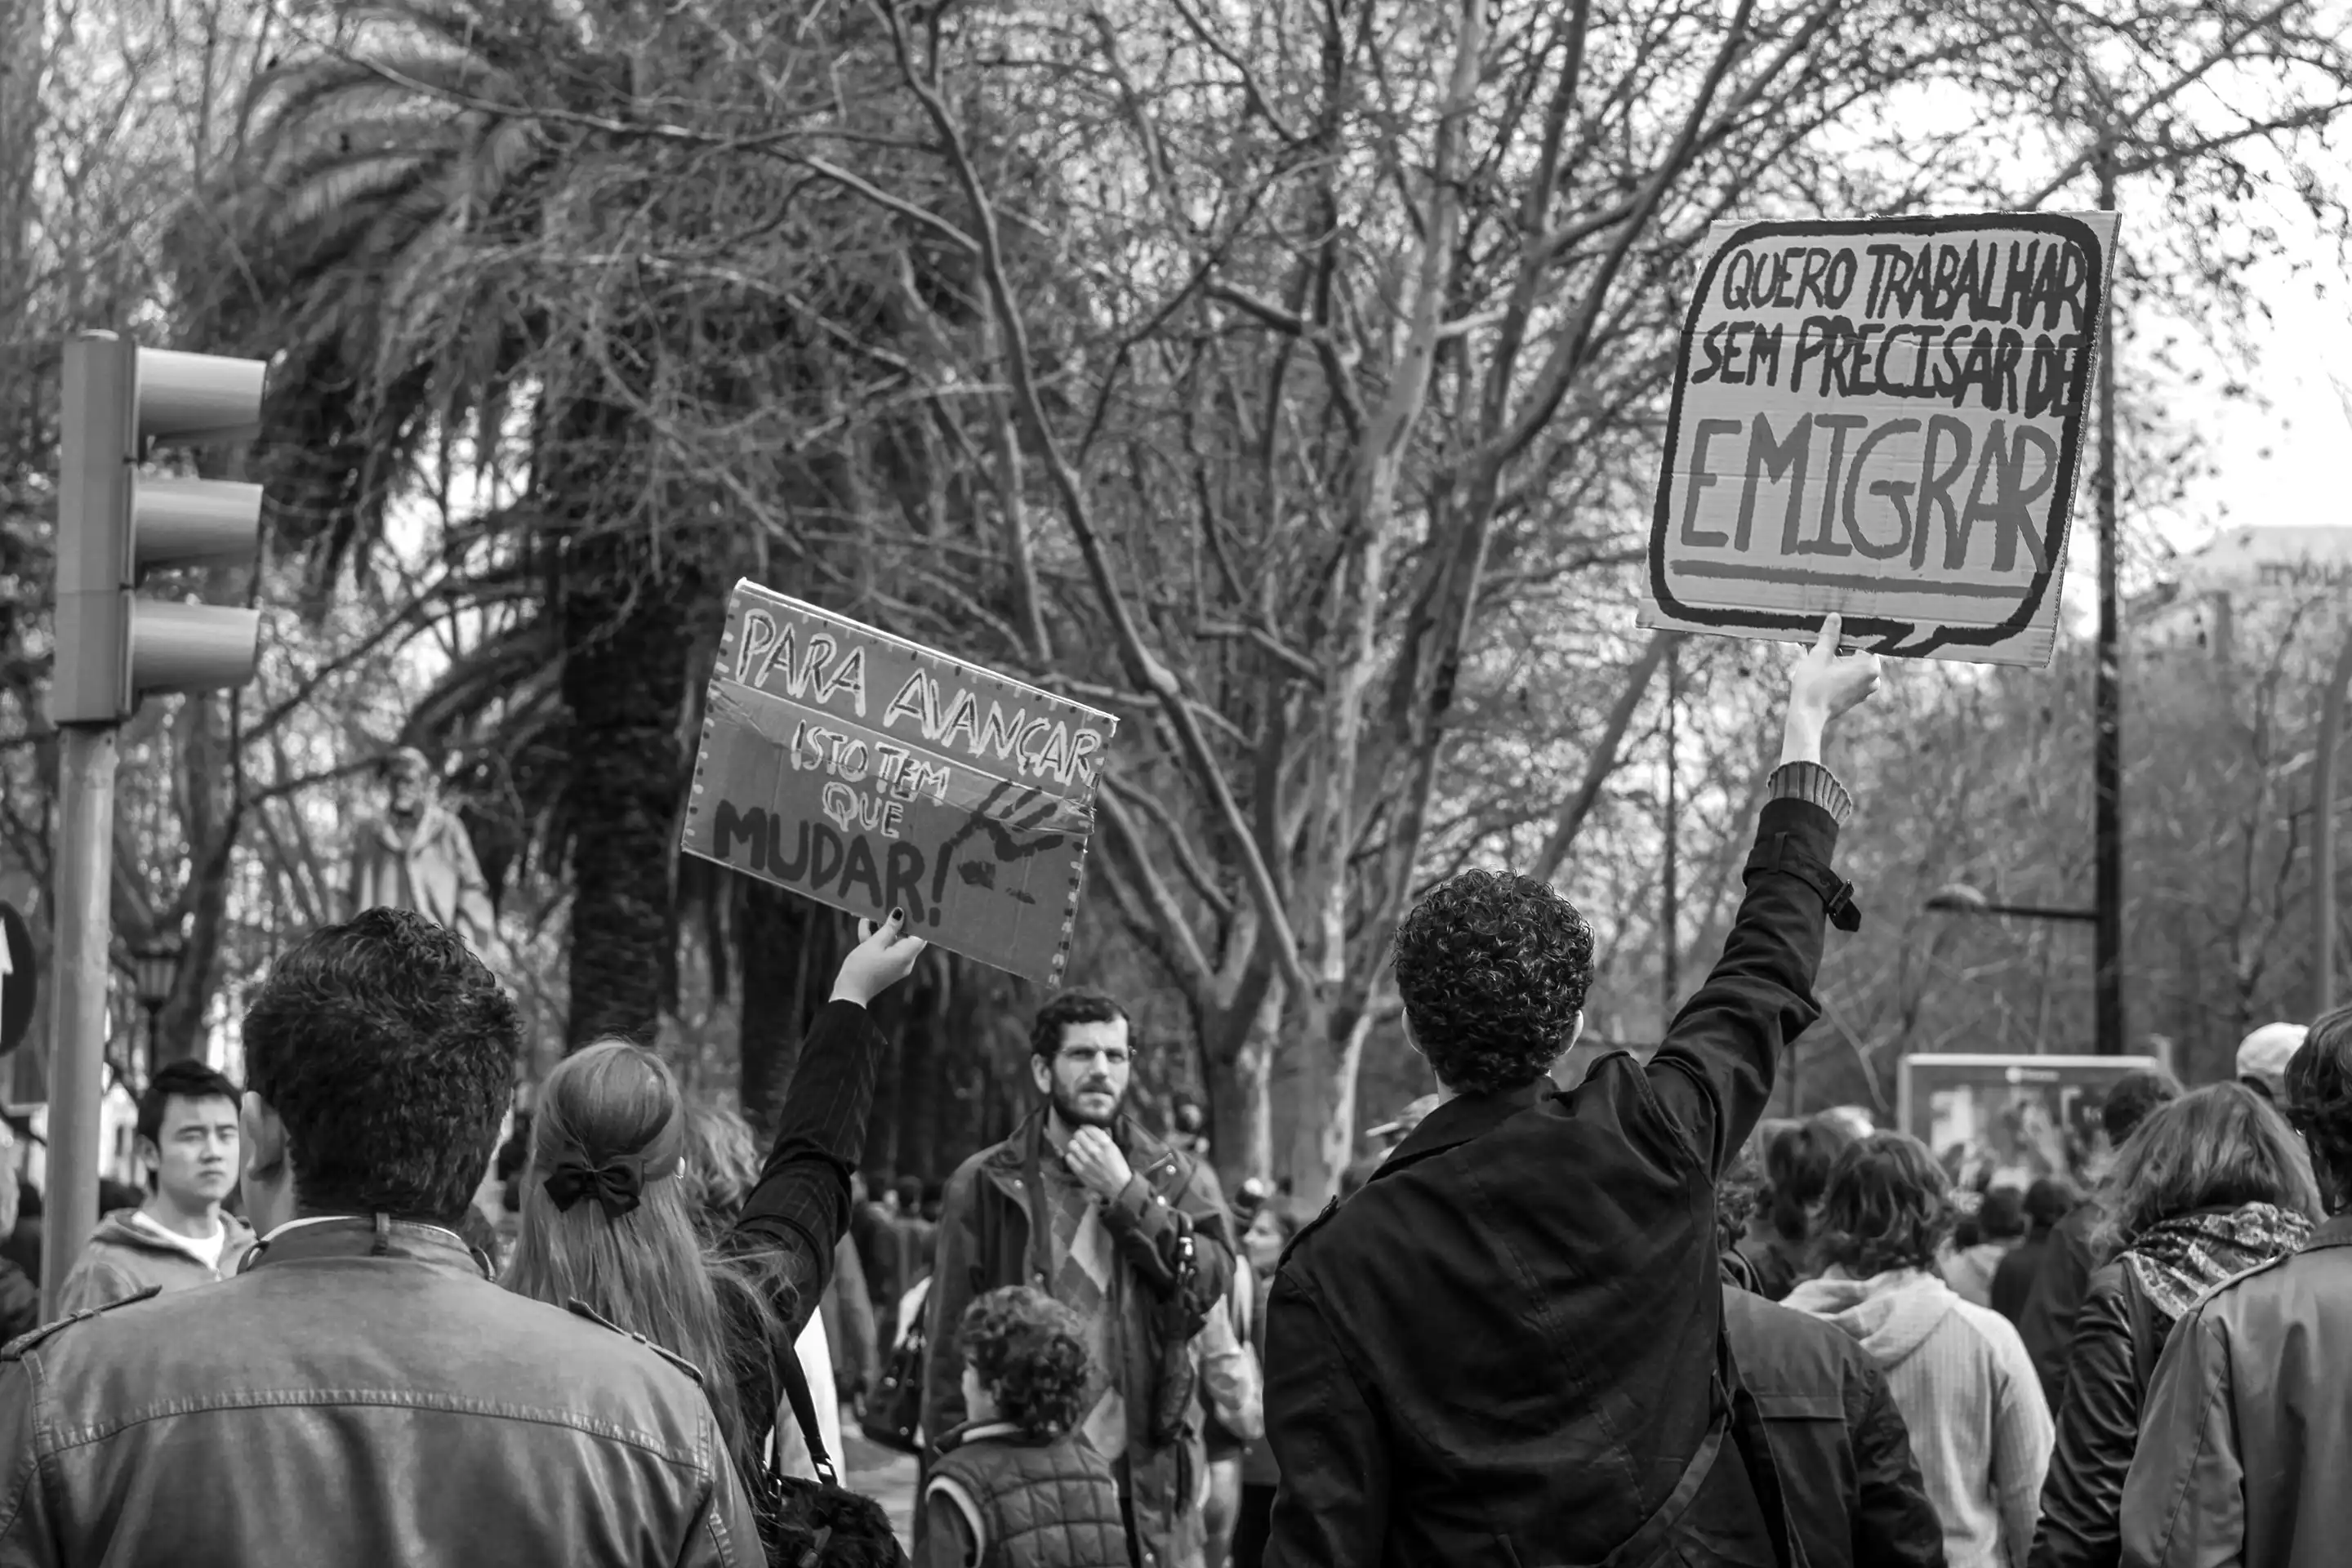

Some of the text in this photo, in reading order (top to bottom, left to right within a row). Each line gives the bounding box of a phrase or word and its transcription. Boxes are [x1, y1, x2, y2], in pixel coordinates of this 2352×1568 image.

[1723, 238, 2085, 331] QUERO TRABALHAR
[1690, 315, 2082, 420] SEM PRECISAR DE
[1680, 412, 2059, 572] EMIGRAR
[735, 608, 1101, 786] PARA AVANÇAR
[791, 719, 952, 807] ISTO TEM
[822, 781, 904, 839] QUE
[713, 799, 954, 928] MUDAR!
